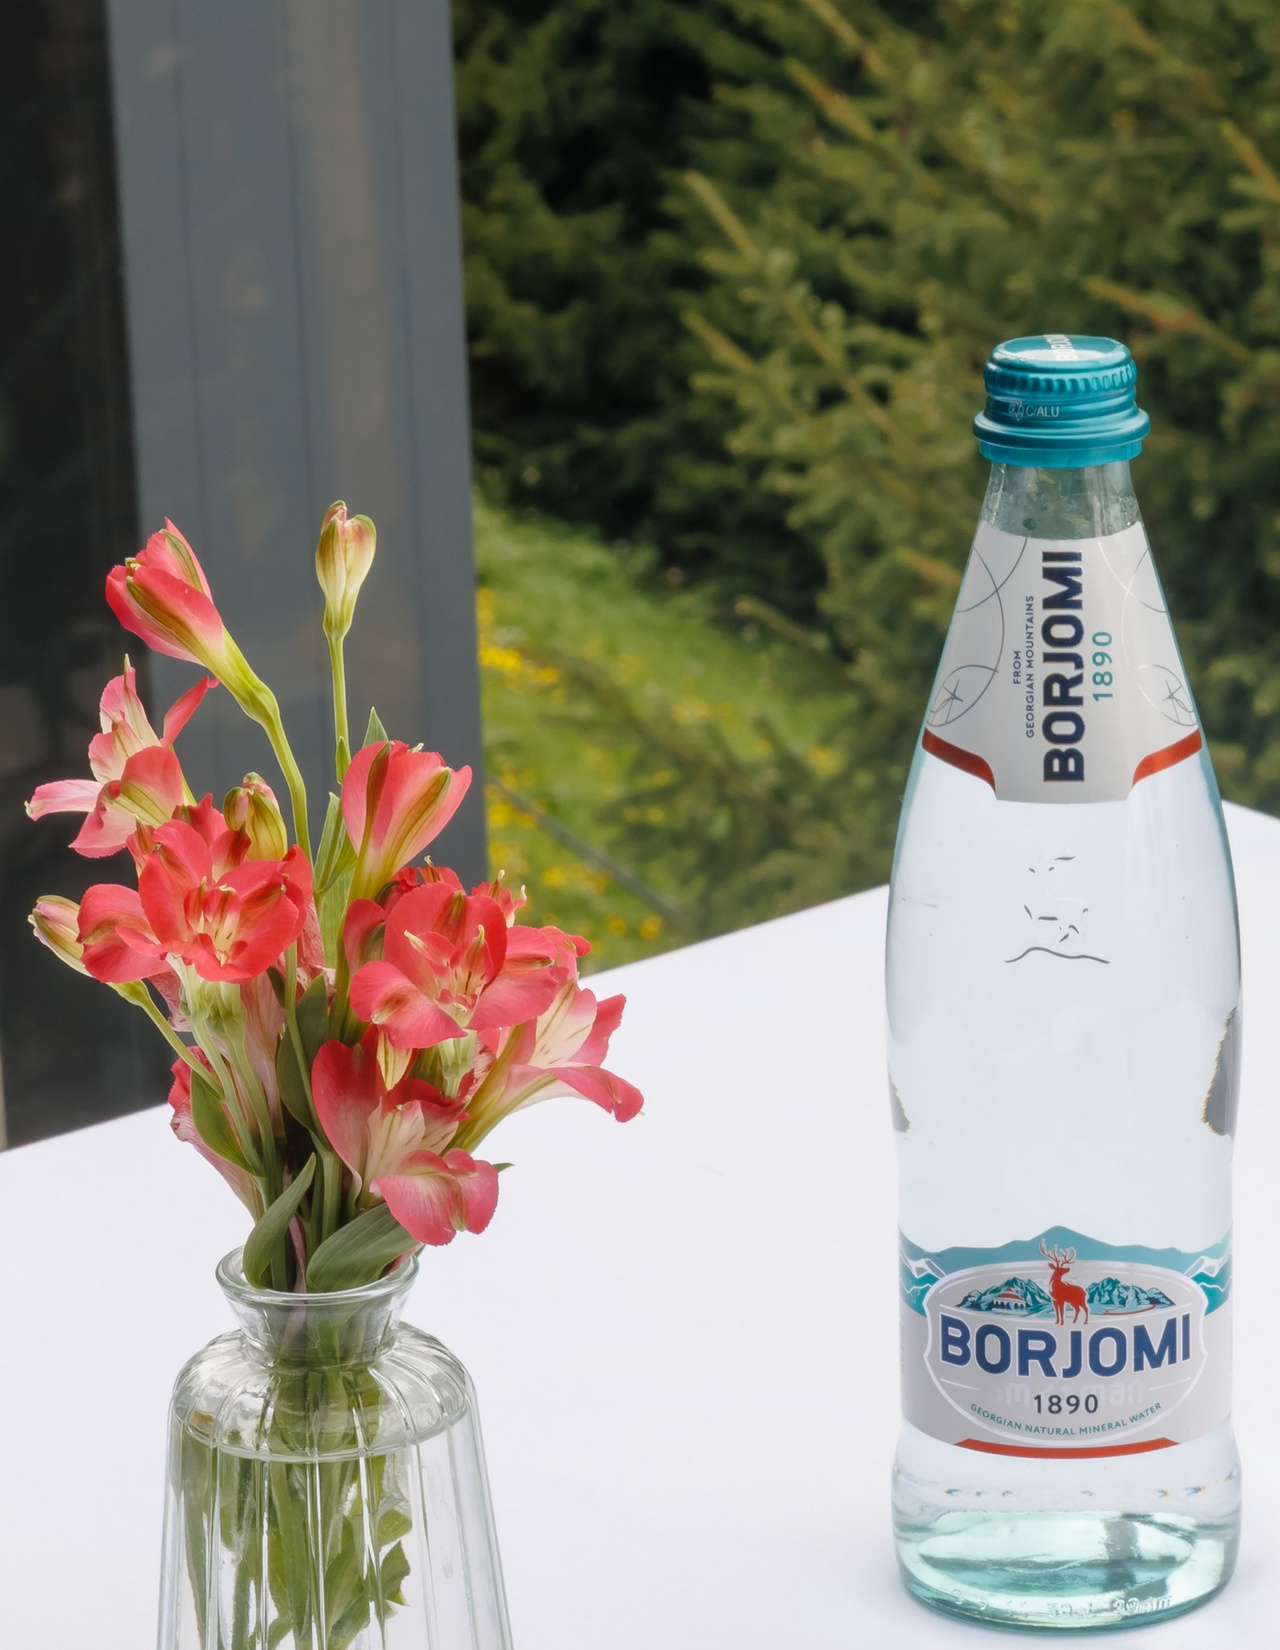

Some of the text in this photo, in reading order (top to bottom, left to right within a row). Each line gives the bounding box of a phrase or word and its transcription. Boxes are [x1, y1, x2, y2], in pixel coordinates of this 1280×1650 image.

[1012, 650, 1021, 685] FROM
[1025, 595, 1035, 739] GEORGIAN MOUNTAINS
[1042, 551, 1086, 783] BORJOMI
[1092, 631, 1114, 702] 1890
[940, 1312, 1192, 1379] BORJOMI
[970, 1402, 1162, 1436] GEORGIAN NATURAL MINERAL WATER
[1033, 1393, 1099, 1415] 1890
